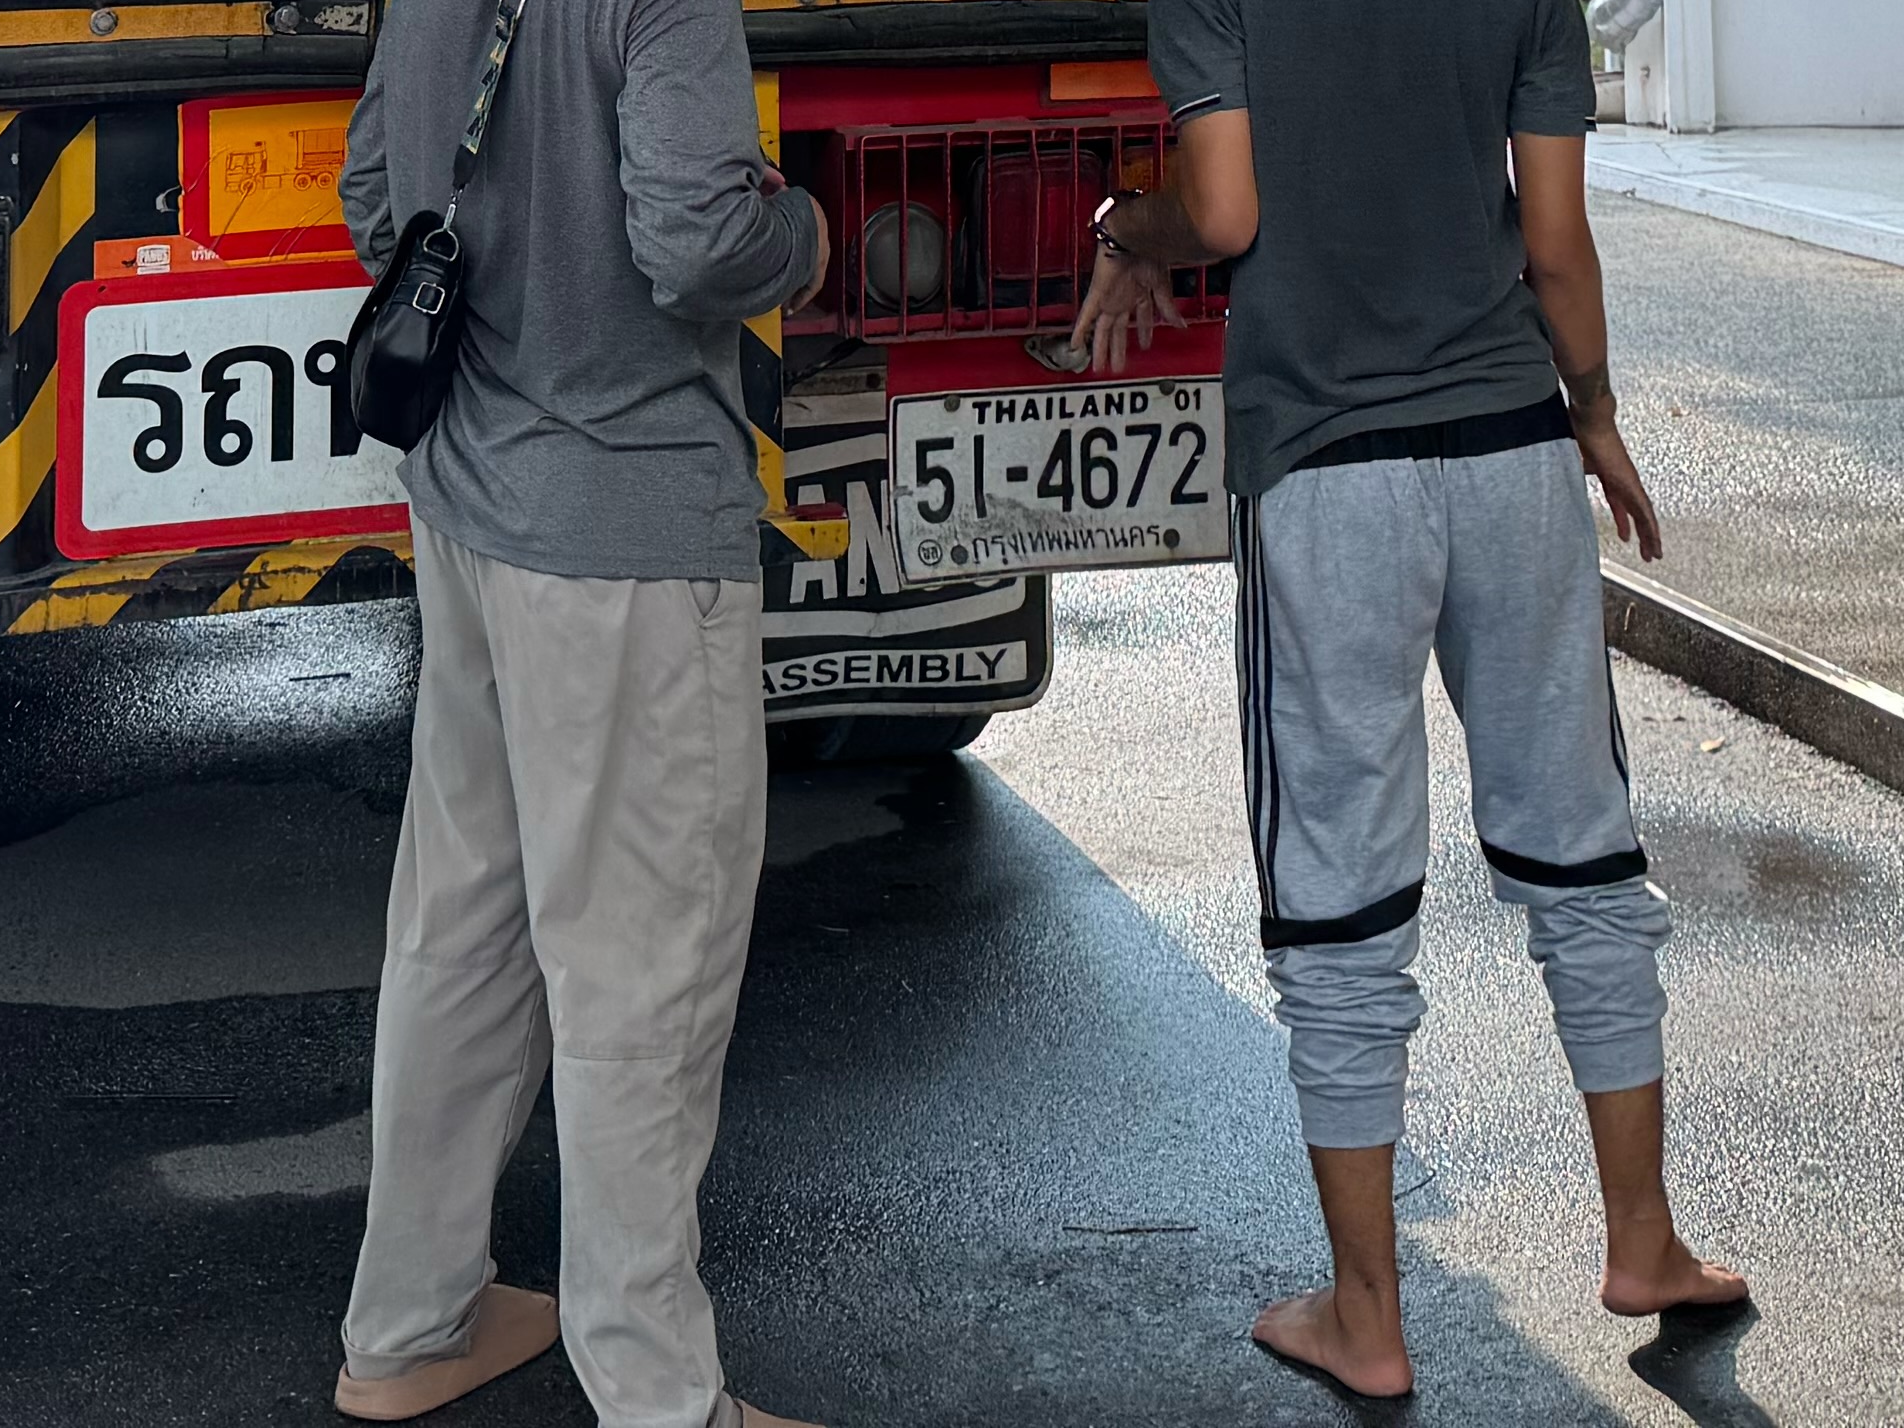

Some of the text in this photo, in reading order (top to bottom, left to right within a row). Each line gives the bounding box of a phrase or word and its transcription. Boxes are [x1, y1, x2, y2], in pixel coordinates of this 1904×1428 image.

[972, 388, 1202, 425] THAILAND 01
[914, 422, 1209, 524] 51-4672
[972, 524, 1161, 566] กรุงเทพมหานคร
